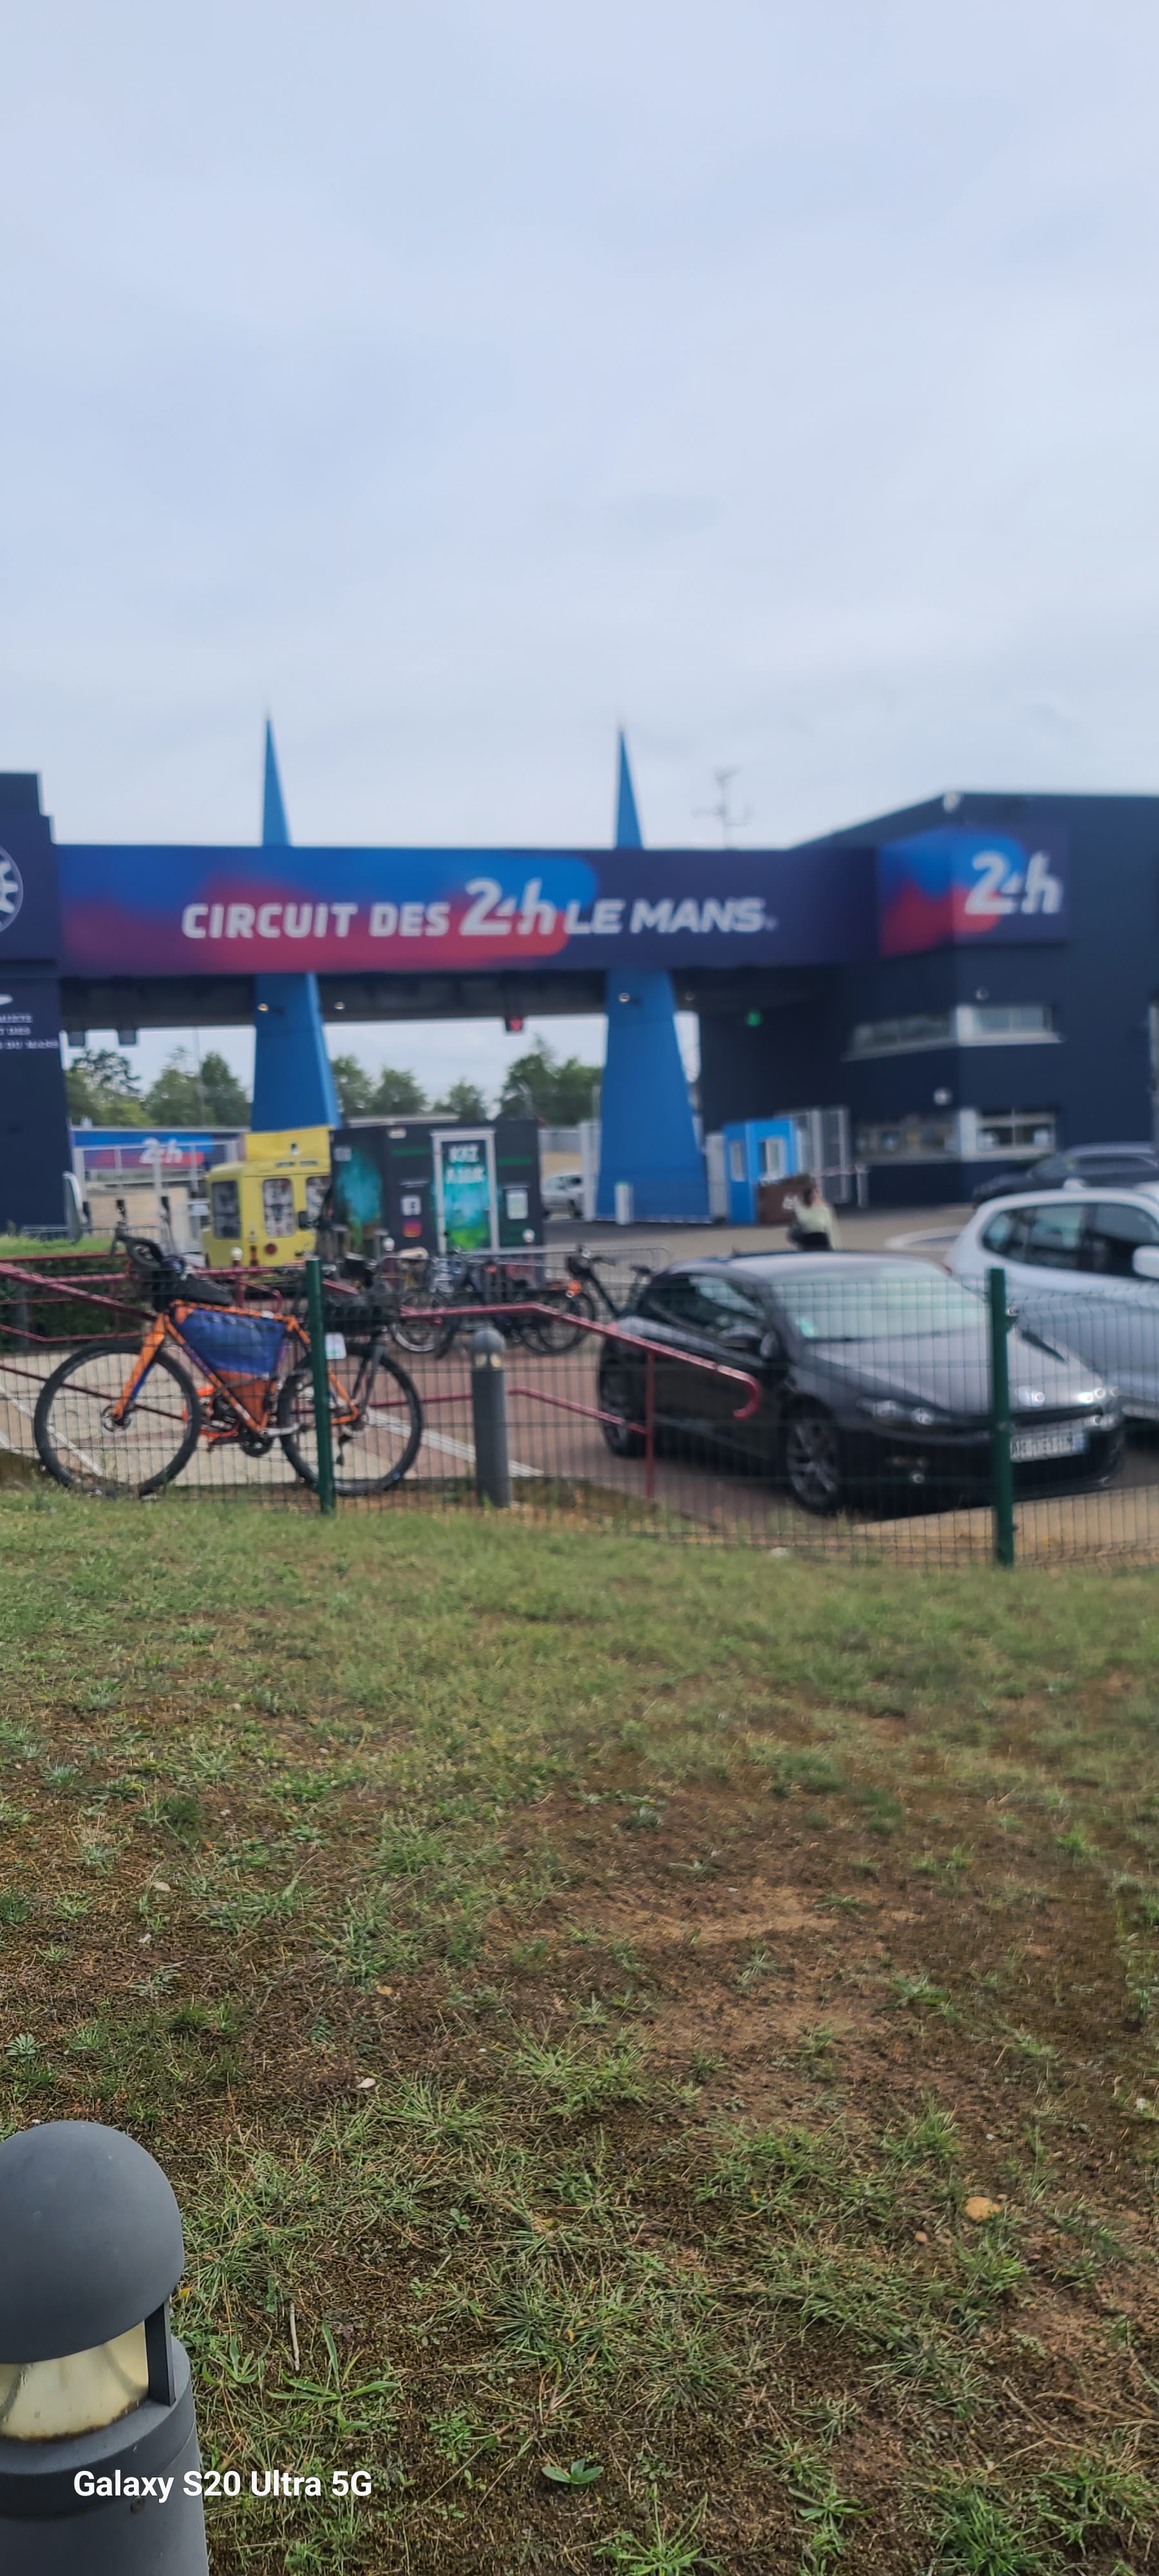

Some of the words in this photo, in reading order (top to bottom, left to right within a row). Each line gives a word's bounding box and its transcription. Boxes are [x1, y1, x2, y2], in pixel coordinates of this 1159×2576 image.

[181, 902, 358, 939] CIRCUIT
[368, 902, 450, 938] DES
[563, 898, 625, 935] LE
